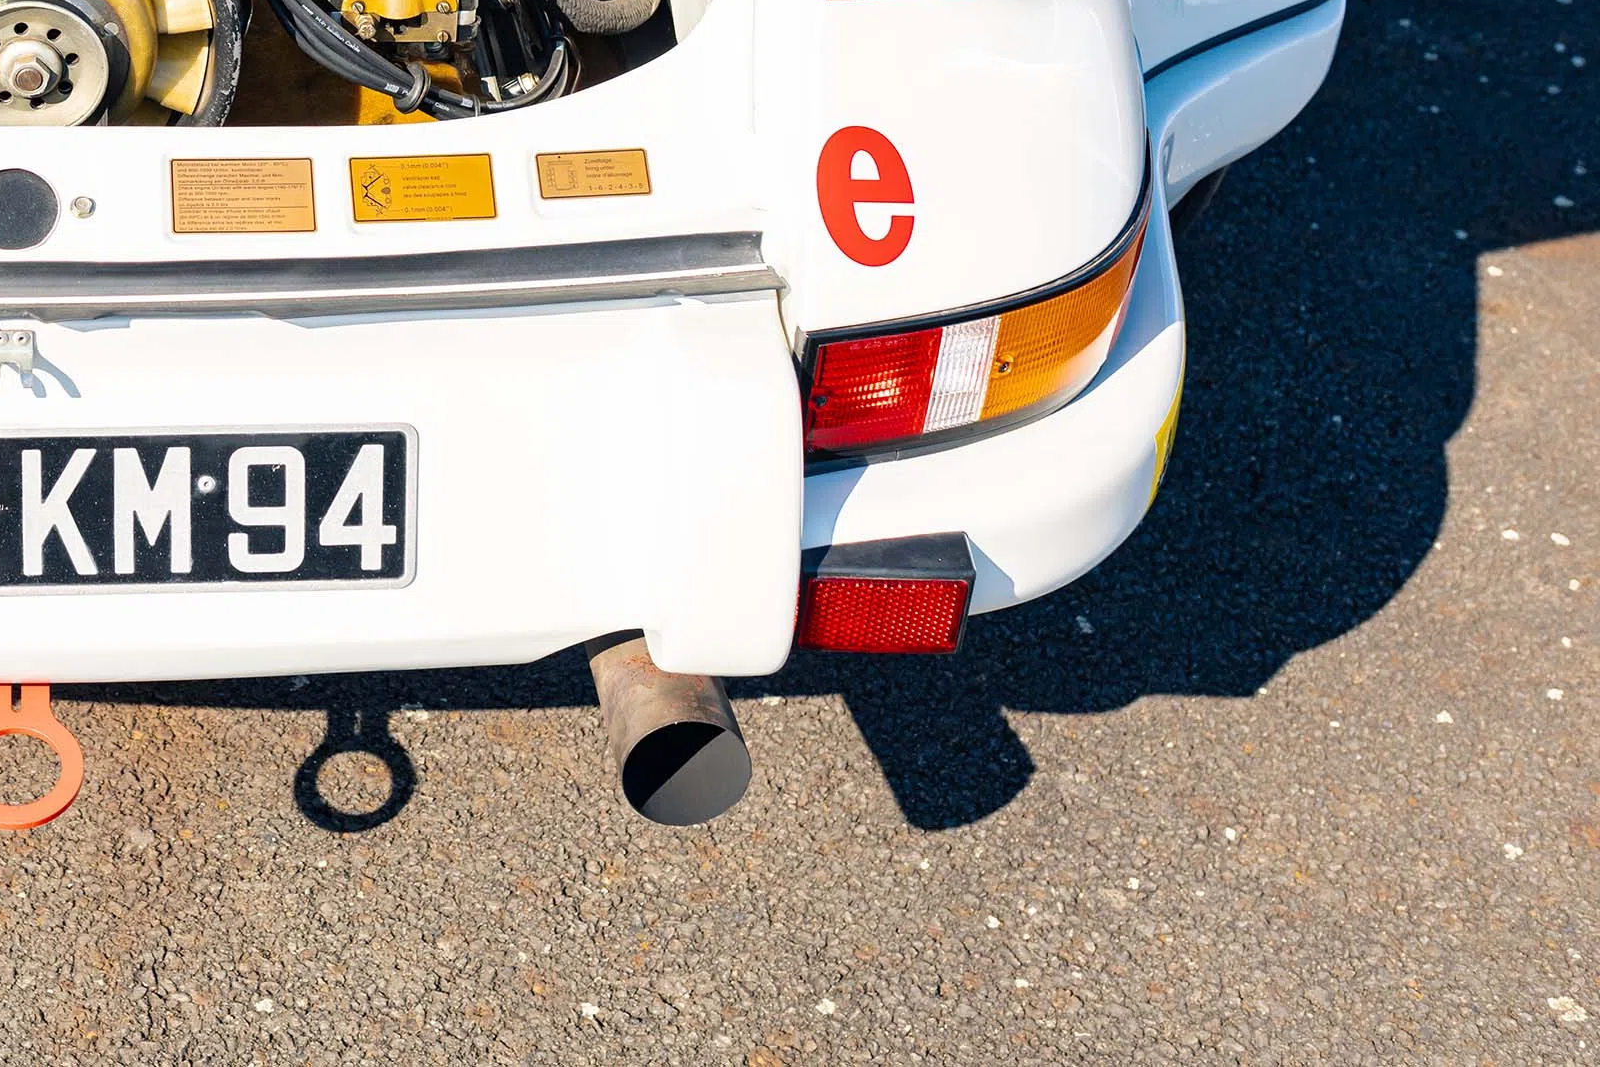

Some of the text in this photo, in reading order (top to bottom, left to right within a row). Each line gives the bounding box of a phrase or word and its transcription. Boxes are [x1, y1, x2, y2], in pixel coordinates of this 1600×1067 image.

[816, 125, 915, 267] e
[20, 445, 194, 579] KM
[226, 443, 398, 575] 94
